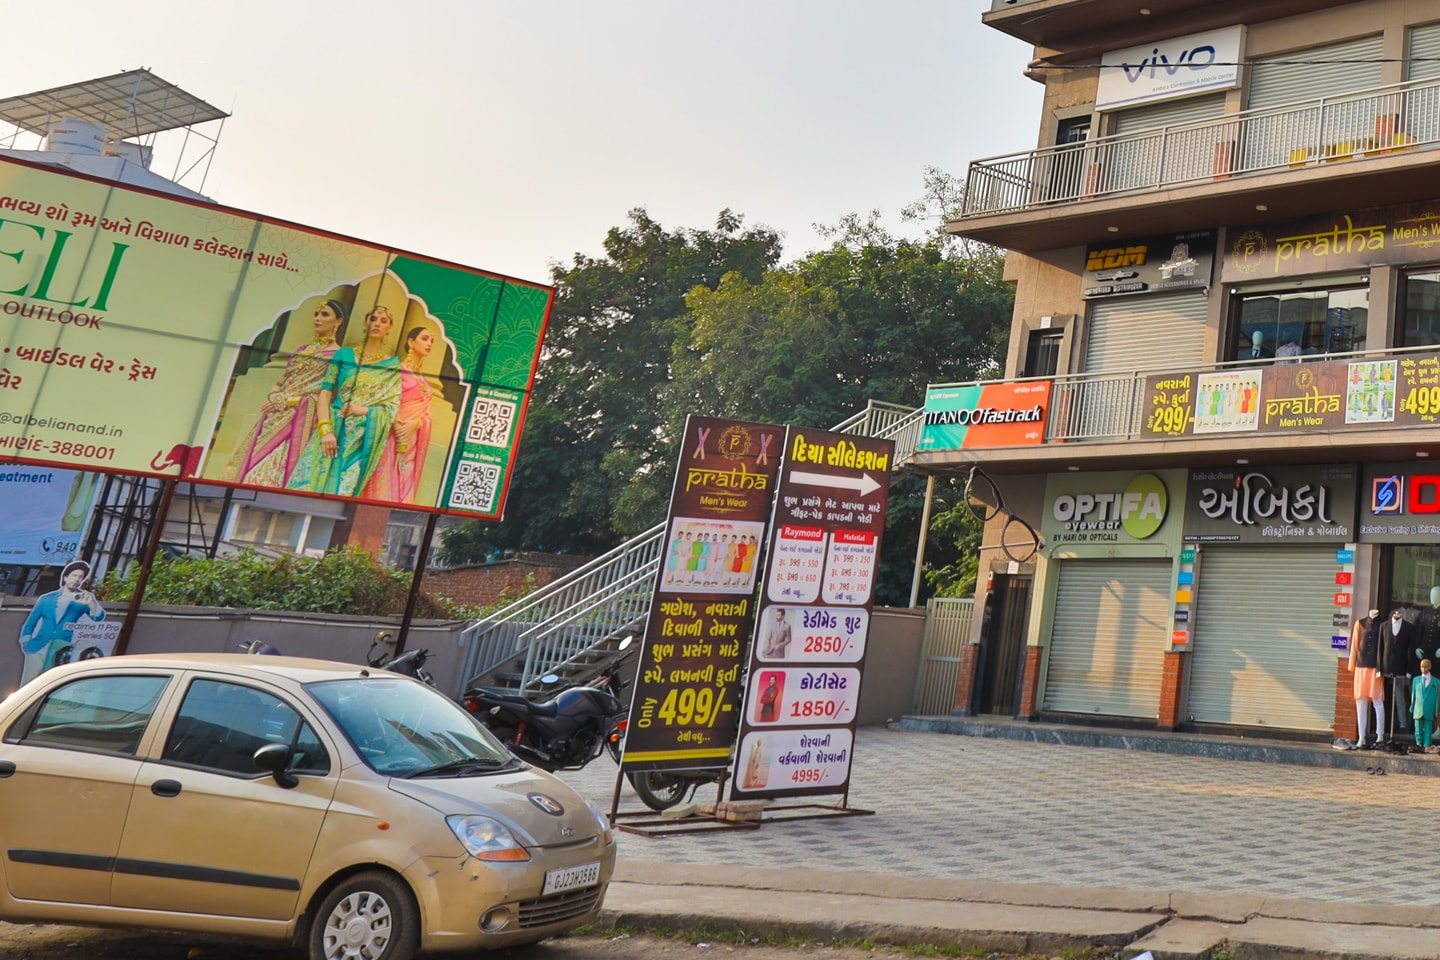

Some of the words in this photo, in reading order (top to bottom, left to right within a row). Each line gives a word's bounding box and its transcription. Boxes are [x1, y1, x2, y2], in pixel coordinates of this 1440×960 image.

[1122, 45, 1216, 83] vivo
[45, 204, 68, 222] શો
[71, 211, 97, 229] રૂમ
[101, 217, 132, 236] અને
[135, 220, 189, 248] વિશાળ
[1275, 214, 1386, 273] pratha
[1393, 226, 1427, 241] Men's
[1086, 245, 1148, 271] KDM
[4, 301, 104, 330] OUTLOOK
[90, 352, 114, 373] વેર
[982, 405, 1041, 424] fastrack
[1266, 386, 1341, 424] pratha
[1279, 418, 1302, 427] Men's
[1304, 417, 1323, 426] Wear
[686, 463, 768, 491] pratha
[700, 496, 724, 506] Men's
[727, 497, 747, 508] Wear
[1053, 493, 1163, 522] OPTIFA
[784, 527, 821, 538] Raymond
[1065, 522, 1120, 532] eyewear
[1308, 527, 1314, 536] &
[705, 599, 747, 617] નવરાત્રી
[64, 622, 97, 632] realme
[106, 623, 120, 632] Pro
[662, 618, 702, 636] દિવાળી
[709, 619, 737, 636] તેમજ
[803, 610, 837, 629] રેડીમેડ
[77, 631, 101, 640] Series
[103, 632, 116, 640] 5G
[652, 643, 674, 663] શુભ
[682, 639, 712, 658] પ્રસંગ
[719, 640, 739, 657] માટે
[804, 636, 853, 656] 2850/-
[670, 665, 713, 683] લખનવી
[800, 672, 847, 690] કોટીસેટ
[638, 698, 658, 728] Only
[658, 687, 732, 728] 499/-
[790, 700, 849, 719] 1850/-
[792, 769, 829, 784] 4995/-
